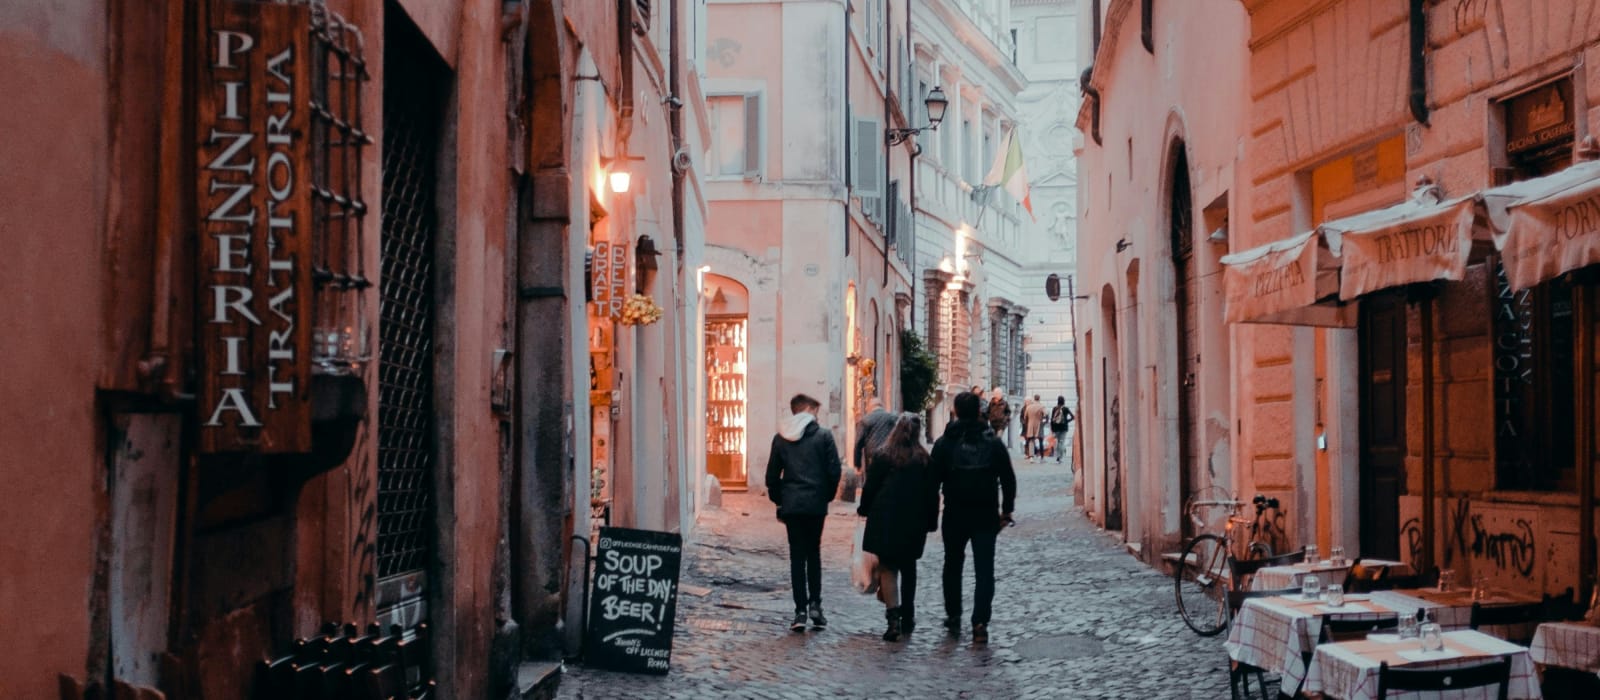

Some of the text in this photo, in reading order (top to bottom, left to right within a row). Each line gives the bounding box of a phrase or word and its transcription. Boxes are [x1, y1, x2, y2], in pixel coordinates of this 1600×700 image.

[204, 30, 263, 427] PIZZERIA
[266, 47, 294, 409] TRATTORIA
[593, 242, 608, 316] CRAFT
[610, 246, 625, 318] BEER
[598, 574, 677, 604] OF THE DAY:
[604, 550, 662, 577] SOUP
